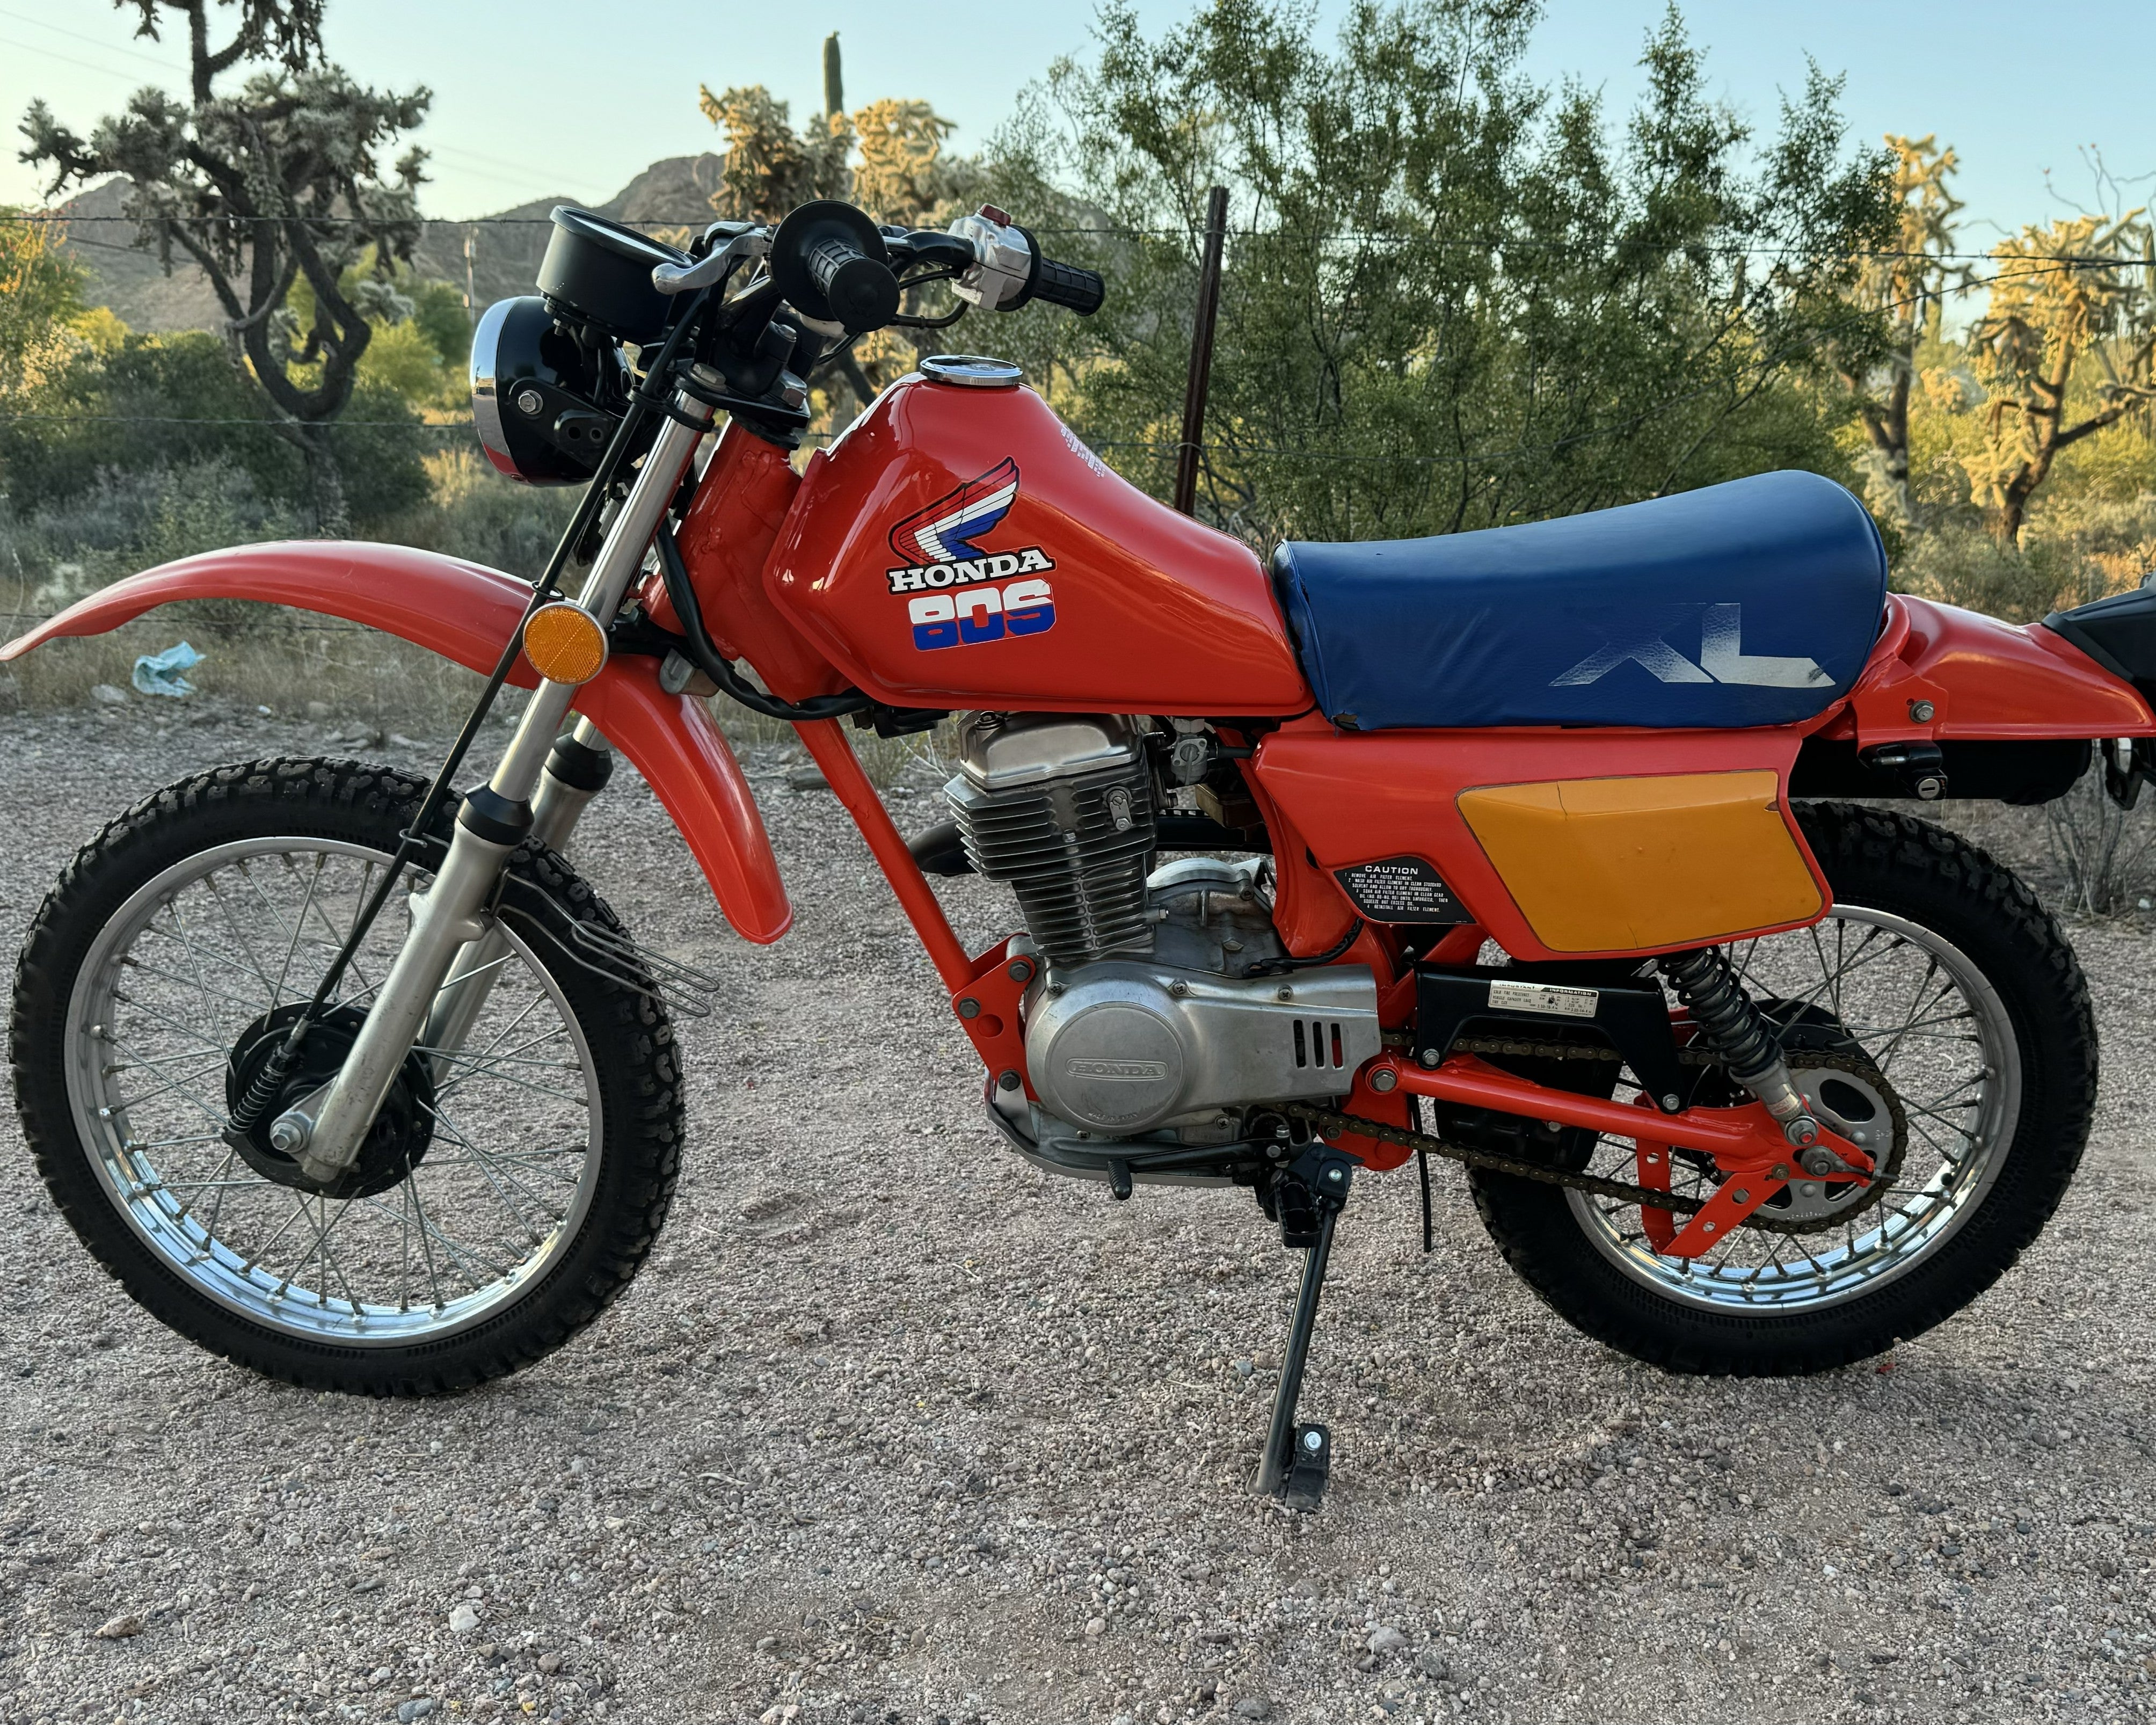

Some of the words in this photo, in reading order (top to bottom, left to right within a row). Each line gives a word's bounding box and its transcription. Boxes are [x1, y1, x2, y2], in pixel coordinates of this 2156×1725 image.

[889, 549, 1053, 592] HONDA
[908, 579, 1057, 652] 80S
[1548, 603, 1836, 688] XL
[1365, 865, 1418, 875] CAUTION
[1549, 988, 1592, 996] INFORMATION
[1072, 1061, 1162, 1074] HONDA
